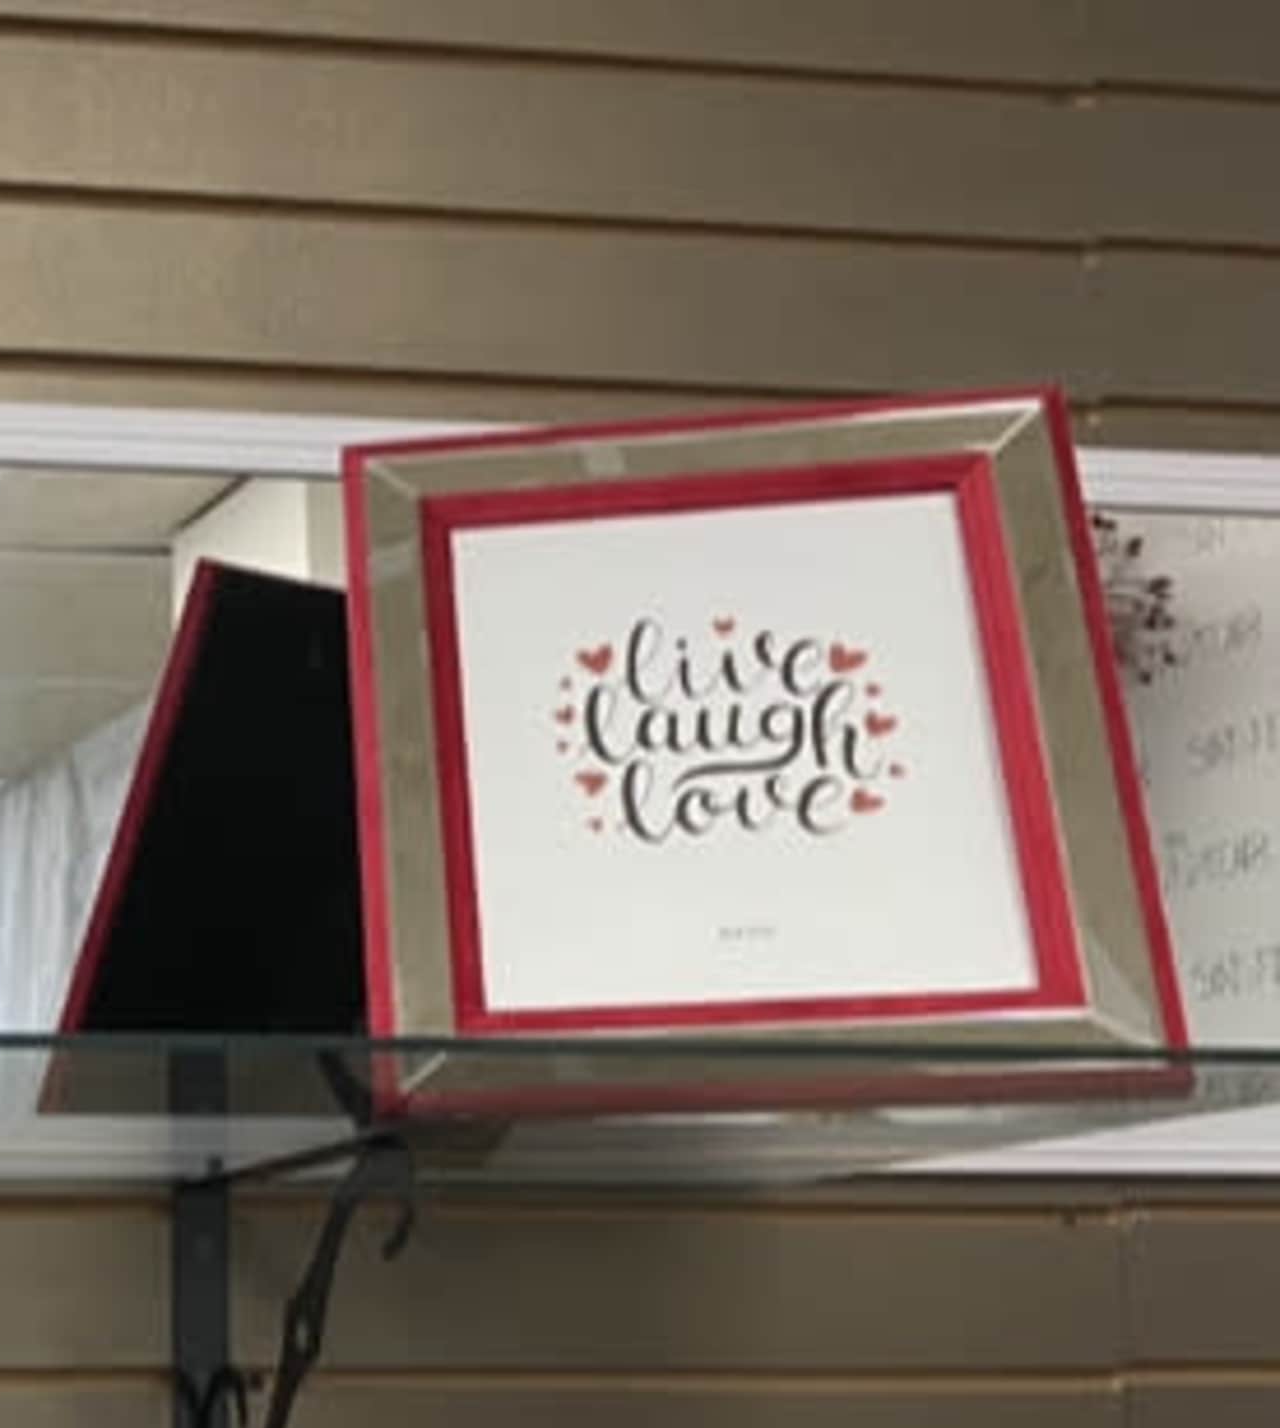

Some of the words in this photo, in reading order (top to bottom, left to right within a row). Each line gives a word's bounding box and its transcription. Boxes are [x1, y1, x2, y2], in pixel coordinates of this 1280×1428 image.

[624, 615, 824, 700] live
[584, 680, 882, 790] laugh
[619, 758, 846, 845] love
